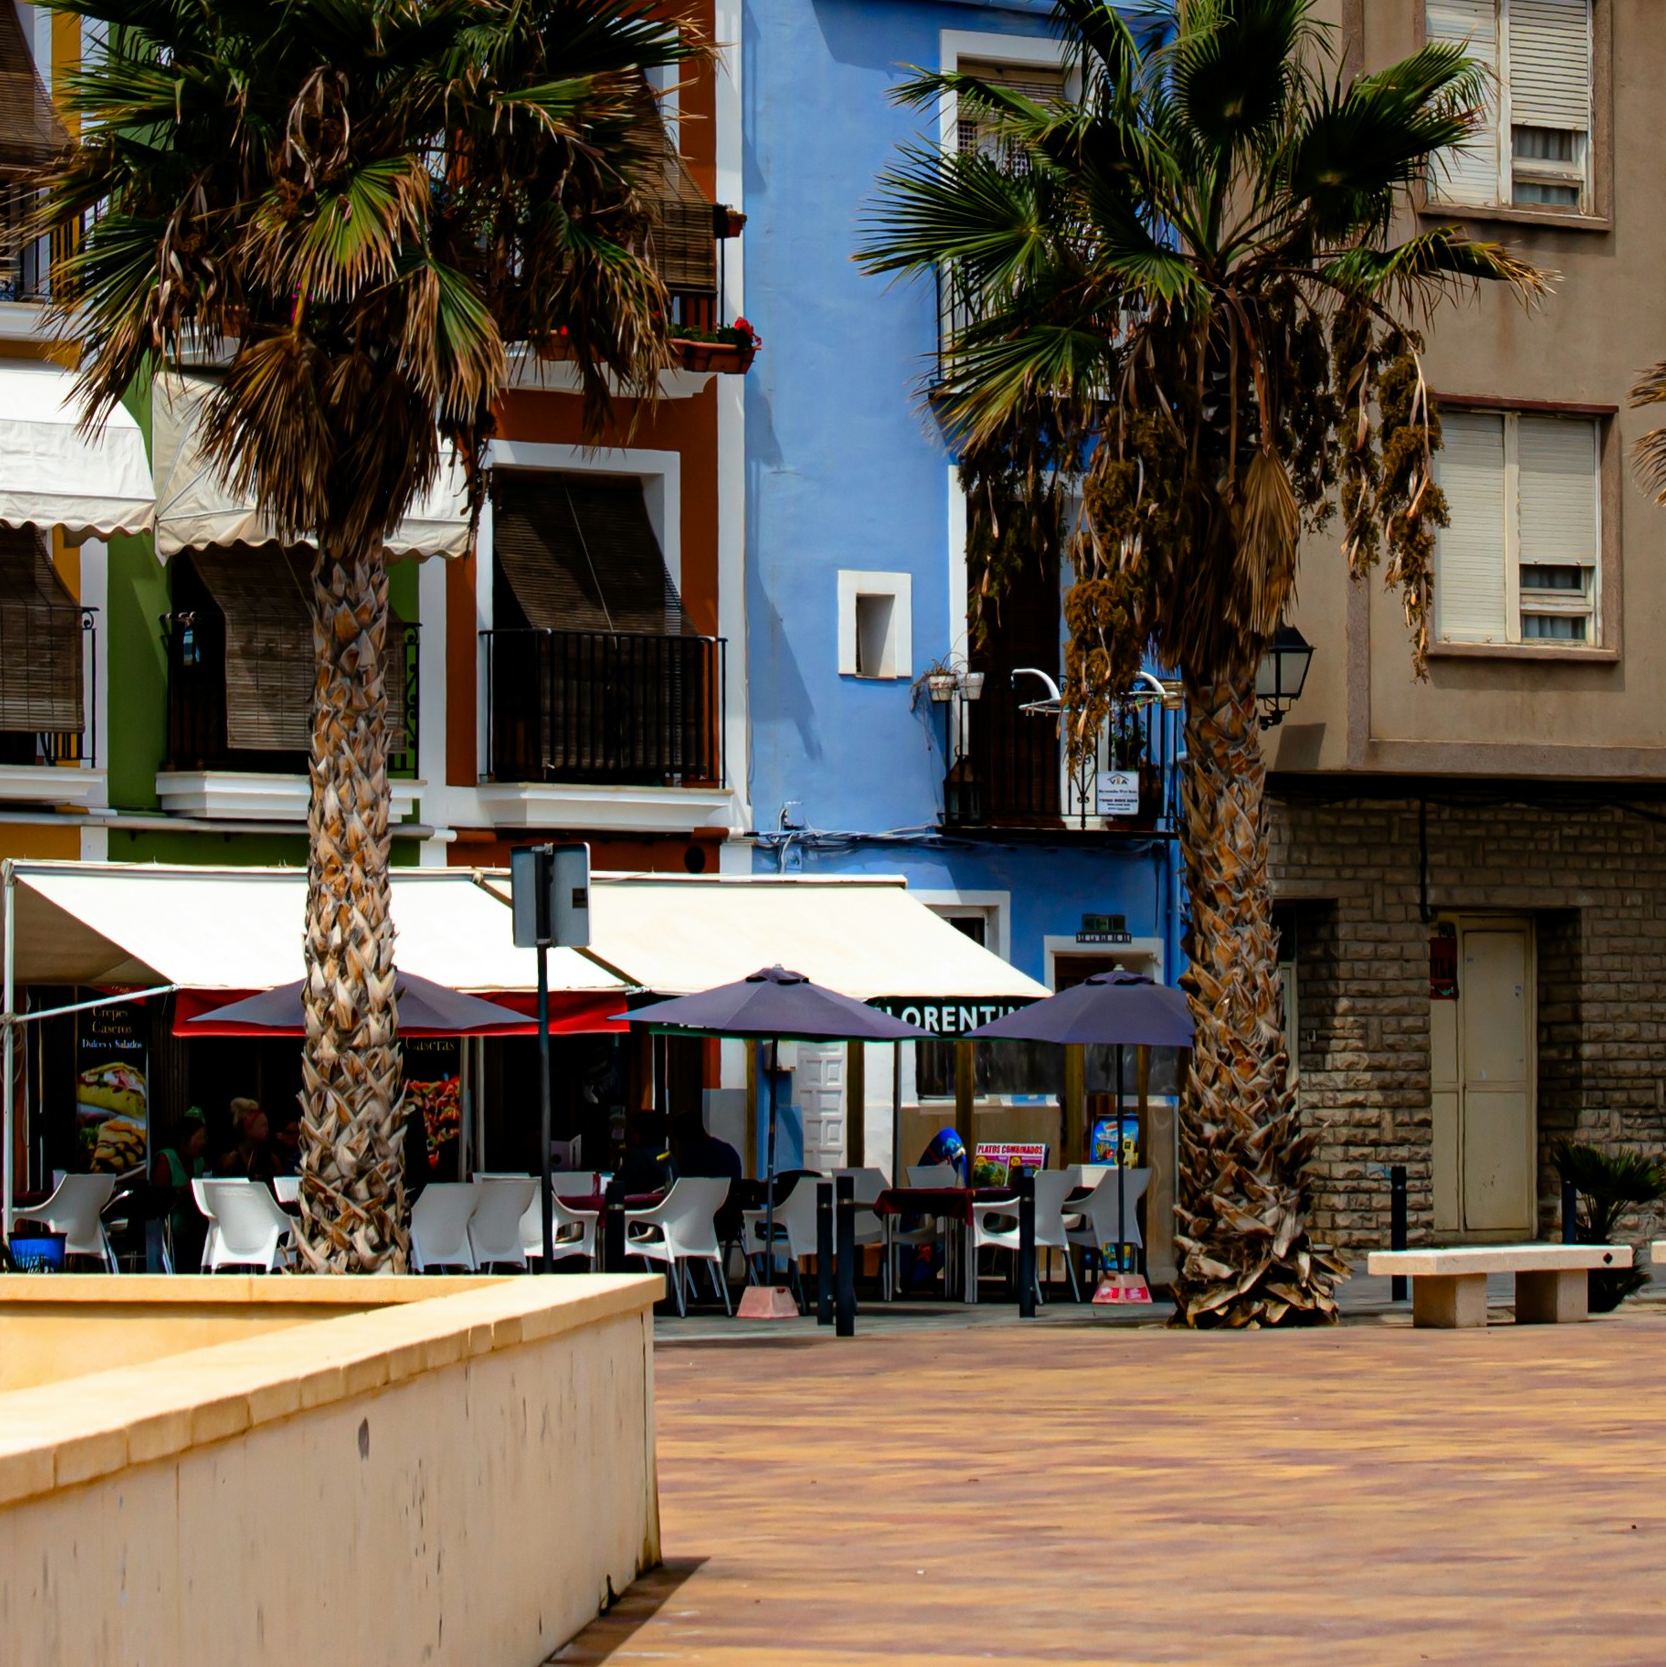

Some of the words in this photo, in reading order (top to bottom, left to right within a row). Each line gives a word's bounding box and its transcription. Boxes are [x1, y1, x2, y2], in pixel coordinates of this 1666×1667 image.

[92, 1020, 132, 1034] Caseros
[82, 1038, 107, 1049] Dulces
[115, 1039, 143, 1049] Salados
[405, 1036, 455, 1052] Caseras
[977, 1144, 1001, 1154] PLATOS
[1001, 1145, 1043, 1155] COMBINADOS
